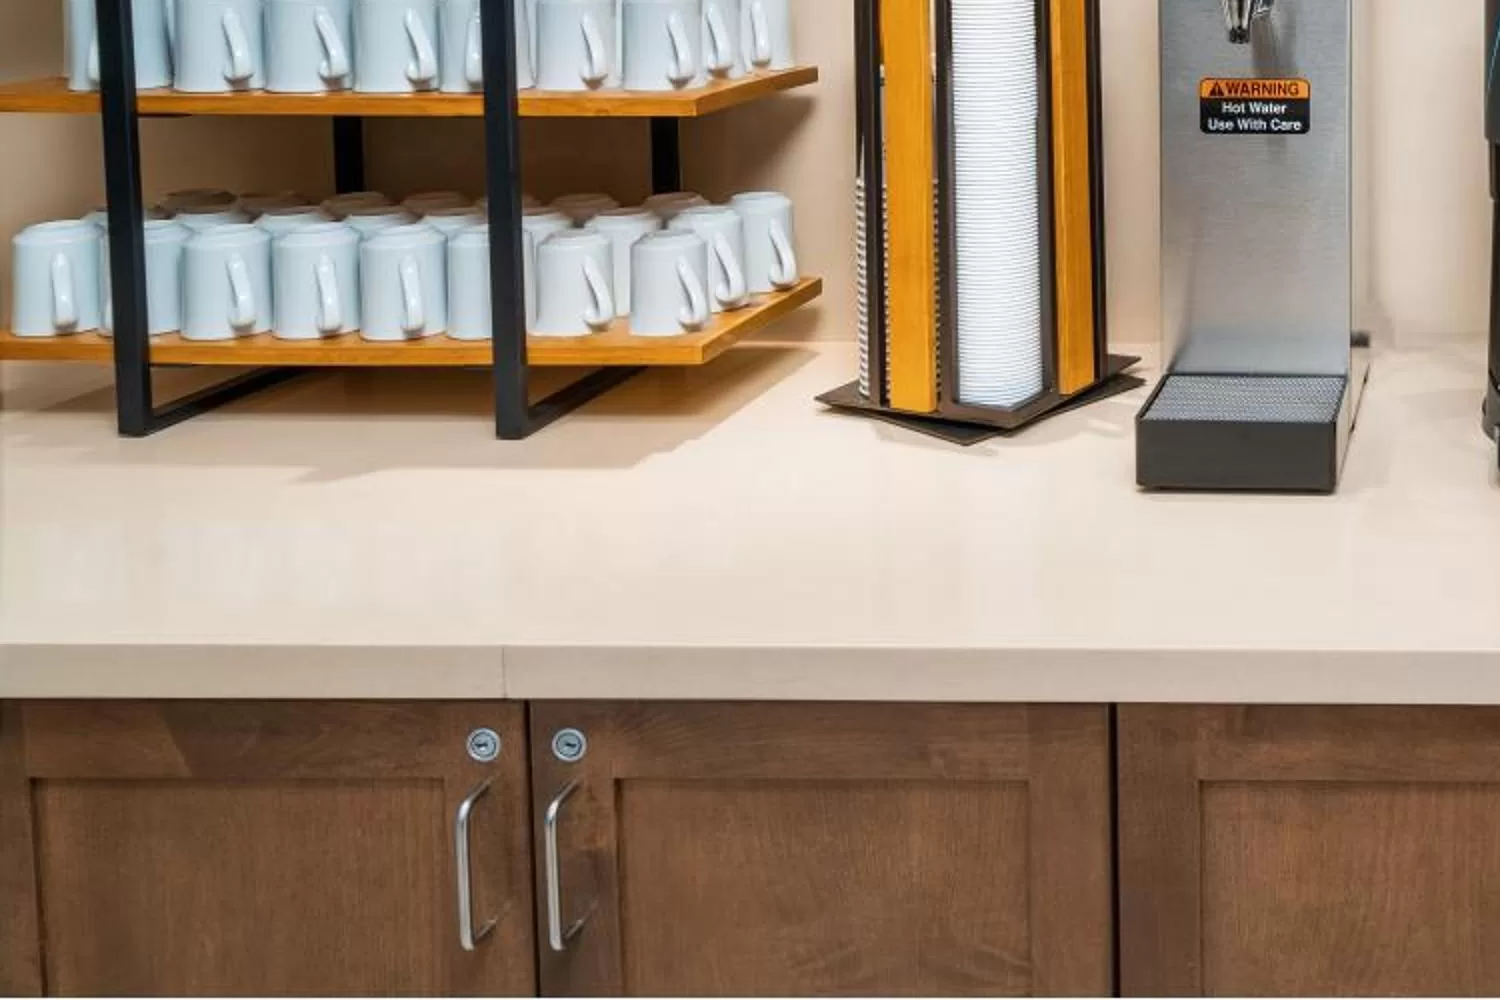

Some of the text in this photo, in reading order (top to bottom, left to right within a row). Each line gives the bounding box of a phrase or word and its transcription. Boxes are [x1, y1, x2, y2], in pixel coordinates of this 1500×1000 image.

[1225, 82, 1299, 96] WARNING
[1222, 102, 1287, 114] Hot Water
[1208, 118, 1302, 130] Use With Care
